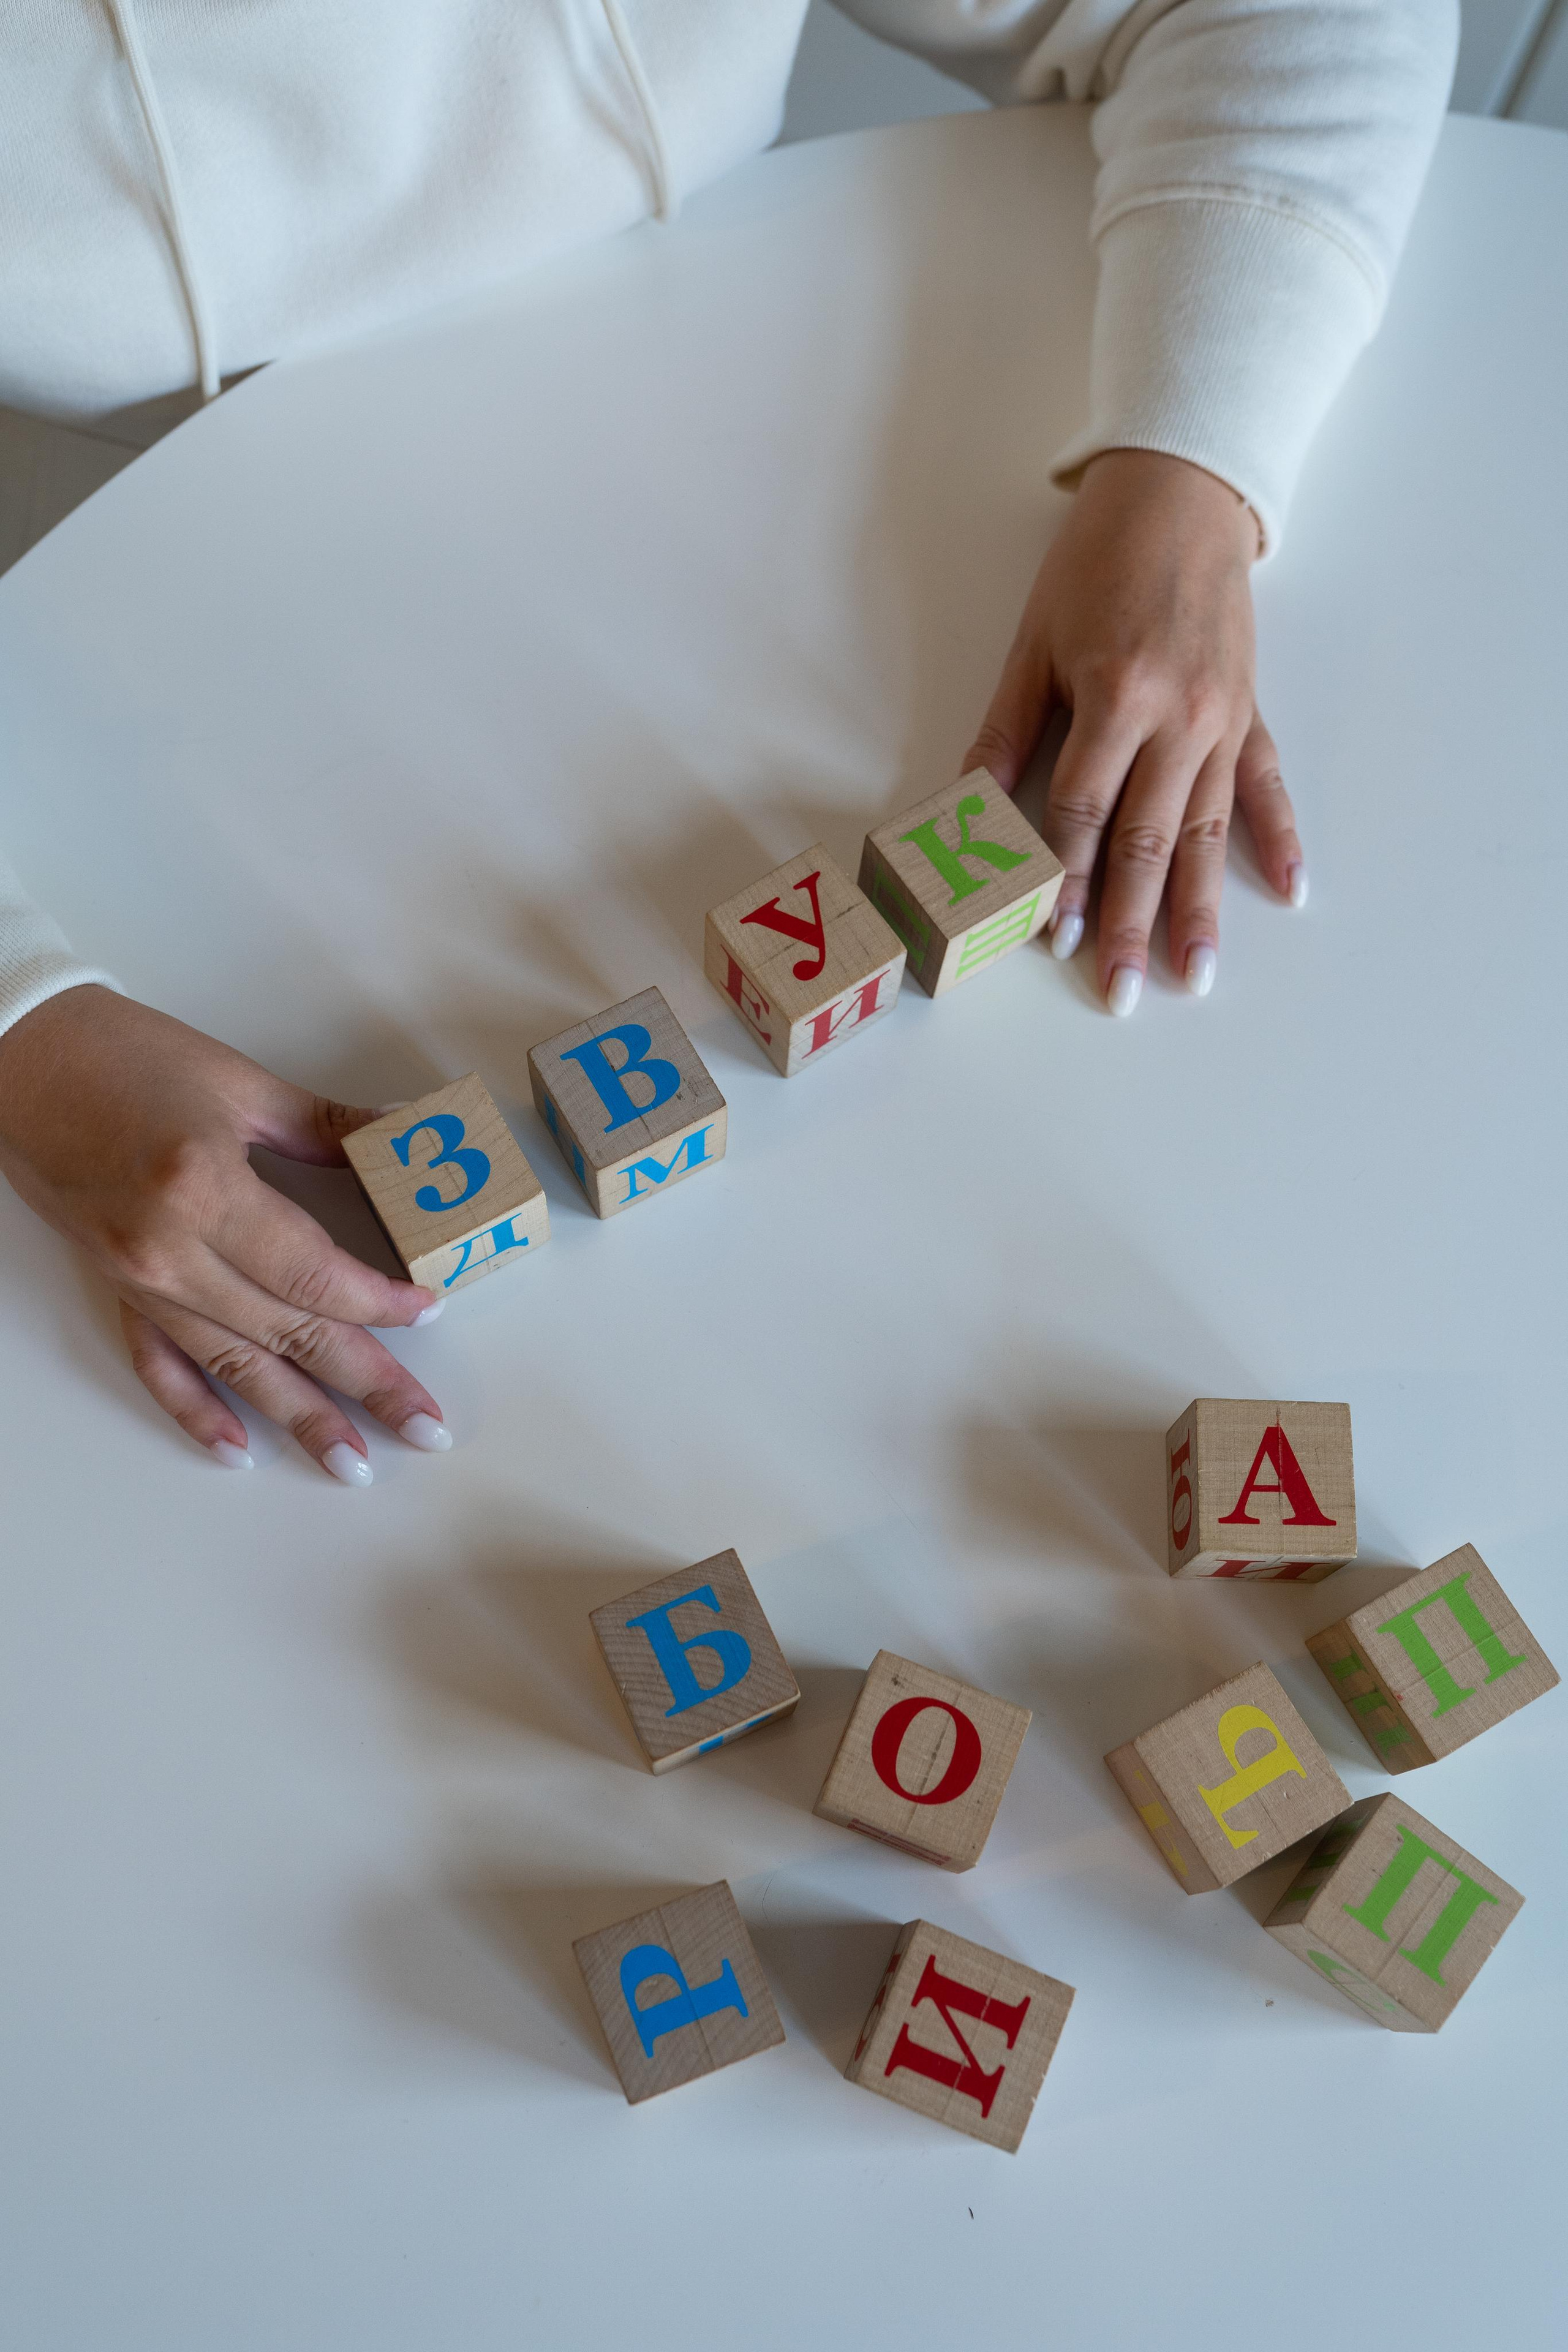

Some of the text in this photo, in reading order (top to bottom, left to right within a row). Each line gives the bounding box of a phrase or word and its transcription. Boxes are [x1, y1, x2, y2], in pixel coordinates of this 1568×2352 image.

[956, 891, 1042, 979] Ш
[390, 795, 1032, 1212] З В У К
[720, 944, 772, 1046] Е
[802, 969, 891, 1059] И
[617, 1123, 715, 1204] М
[443, 1213, 529, 1287] Д
[1218, 1426, 1336, 1526] А
[625, 1585, 752, 1717] Б
[1376, 1570, 1528, 1719] П
[872, 1697, 982, 1806] О
[1343, 1824, 1499, 1987] П
[620, 1944, 748, 2058] Р
[884, 1954, 1031, 2119] И
